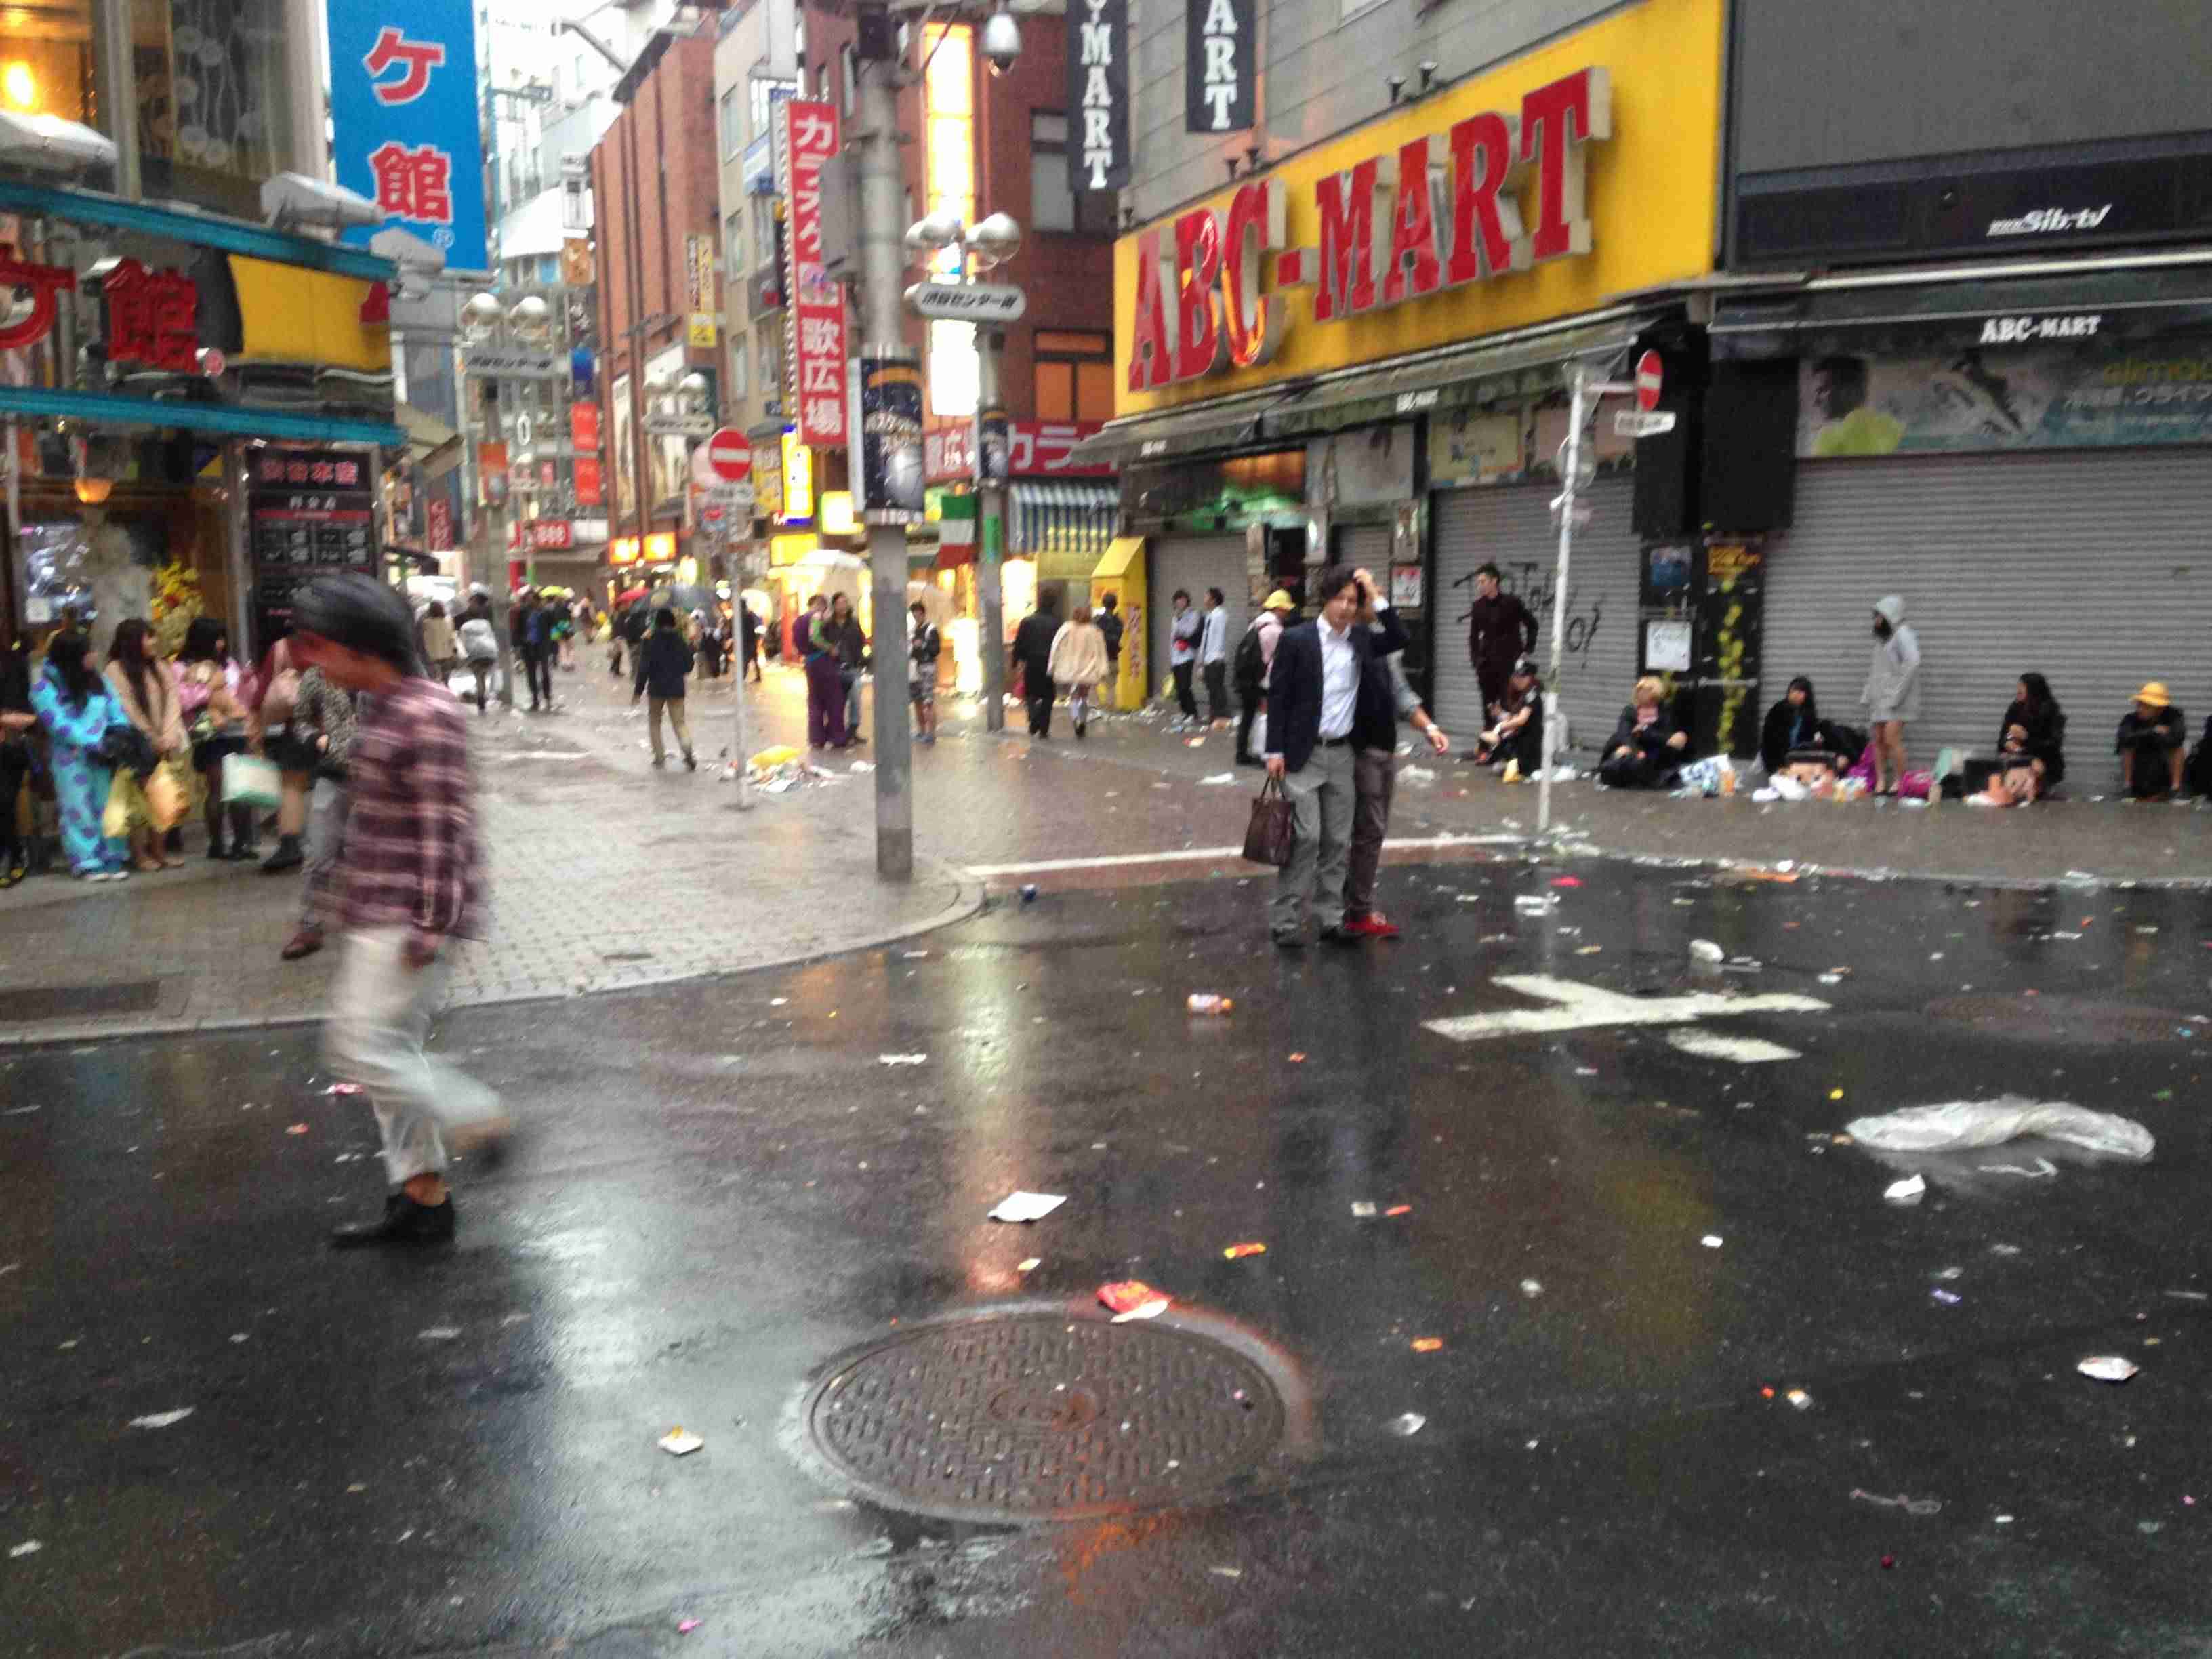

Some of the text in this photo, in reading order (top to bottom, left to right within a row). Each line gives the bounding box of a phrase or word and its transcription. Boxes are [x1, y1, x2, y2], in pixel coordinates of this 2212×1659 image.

[362, 26, 453, 223] ケ館
[1128, 66, 1612, 393] ABC-MART
[801, 316, 842, 436] 歌広場
[1980, 315, 2101, 343] ABC-MART
[1008, 423, 1118, 472] カラ
